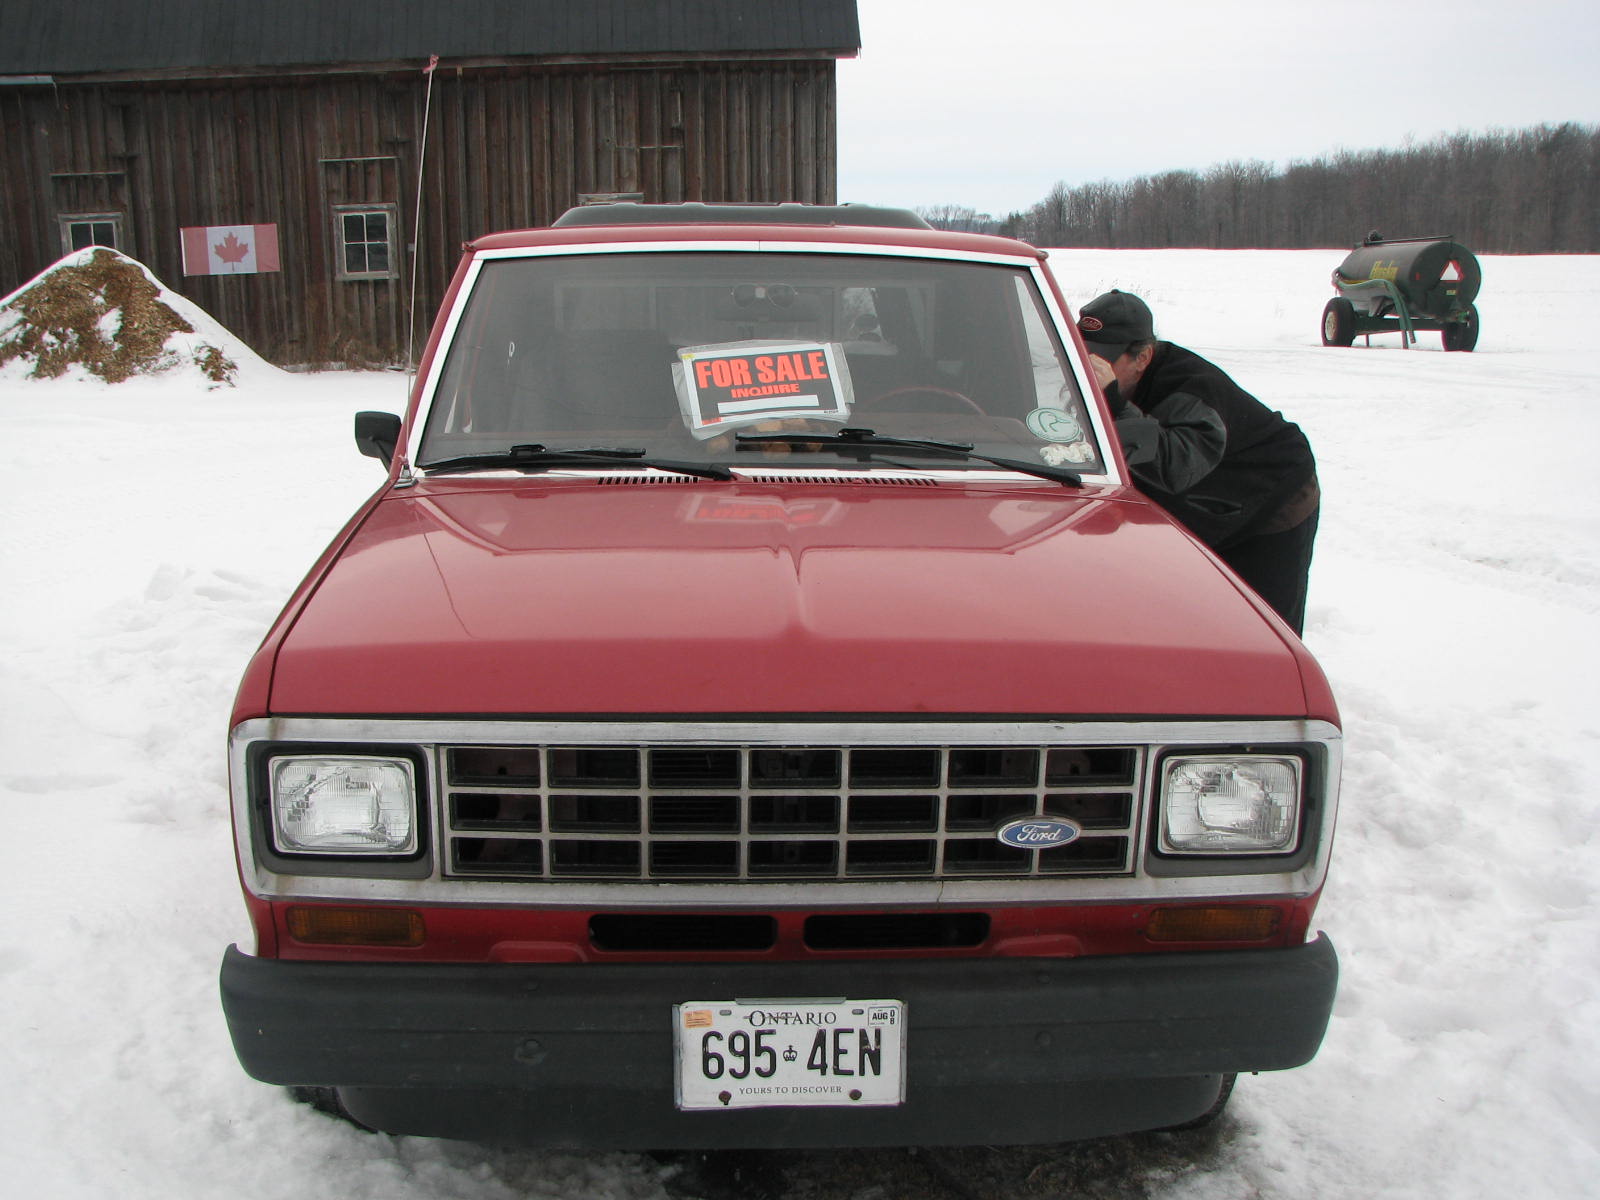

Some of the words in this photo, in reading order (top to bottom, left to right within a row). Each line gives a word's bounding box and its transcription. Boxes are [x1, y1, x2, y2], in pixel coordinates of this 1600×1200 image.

[695, 358, 752, 388] FOR
[755, 351, 828, 383] SALE
[731, 383, 801, 398] INQUIRE
[1016, 824, 1062, 842] Ford
[872, 1012, 888, 1020] AUG
[702, 1028, 776, 1079] 695
[807, 1028, 881, 1076] 4EN
[739, 1087, 771, 1095] YOURS
[792, 1085, 842, 1094] DISCOVER
